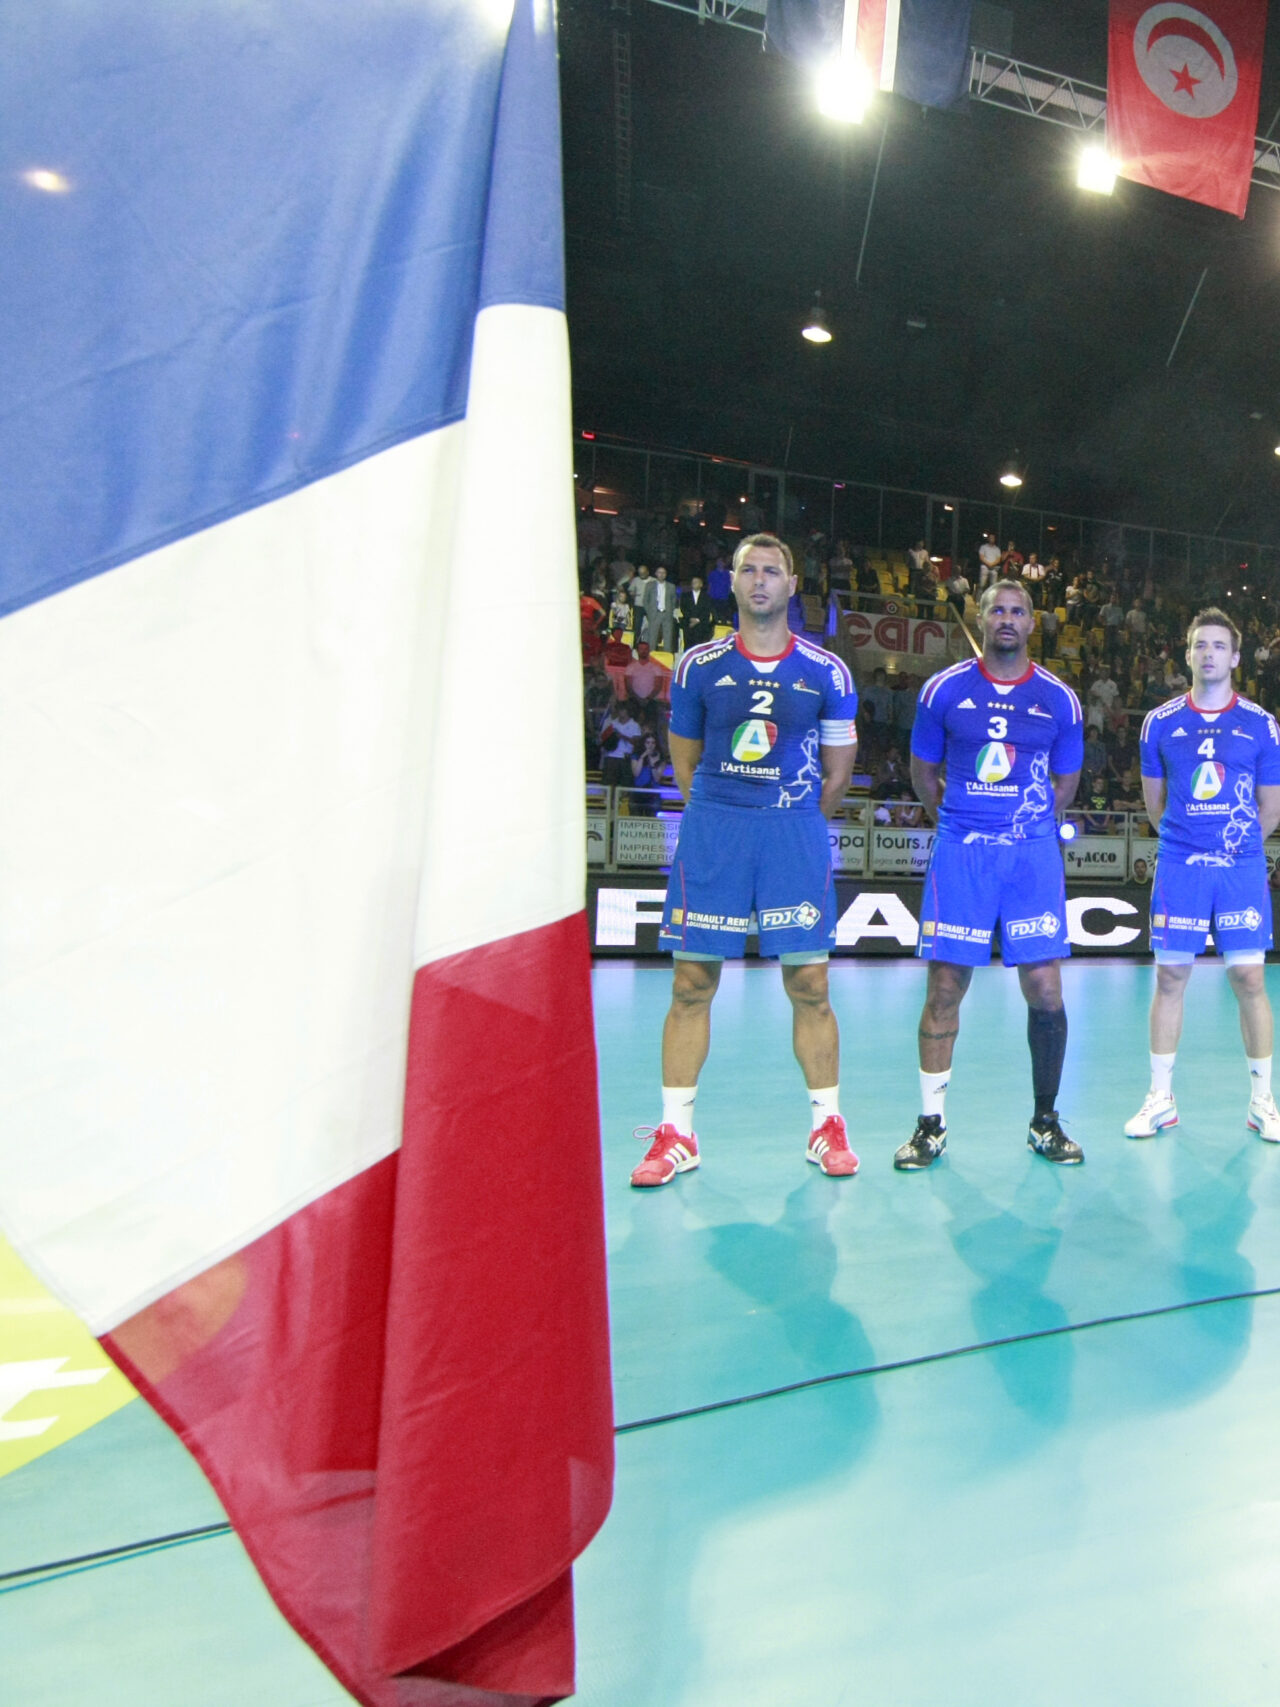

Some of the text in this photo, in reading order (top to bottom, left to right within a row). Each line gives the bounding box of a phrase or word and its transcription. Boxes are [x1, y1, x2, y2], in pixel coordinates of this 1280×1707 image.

[749, 690, 775, 715] 2
[987, 716, 1008, 739] 3
[1197, 738, 1216, 759] 4
[620, 821, 680, 831] IMPRESSI
[828, 834, 864, 850] opa
[1067, 851, 1117, 868] STACCO
[687, 912, 749, 926] RENAULT RENT
[762, 912, 793, 927] FDJ
[1168, 915, 1197, 926] RENAULT
[1218, 915, 1241, 926] FDJ
[937, 922, 992, 939] RENAULT RENT
[1011, 922, 1037, 936] FDJ
